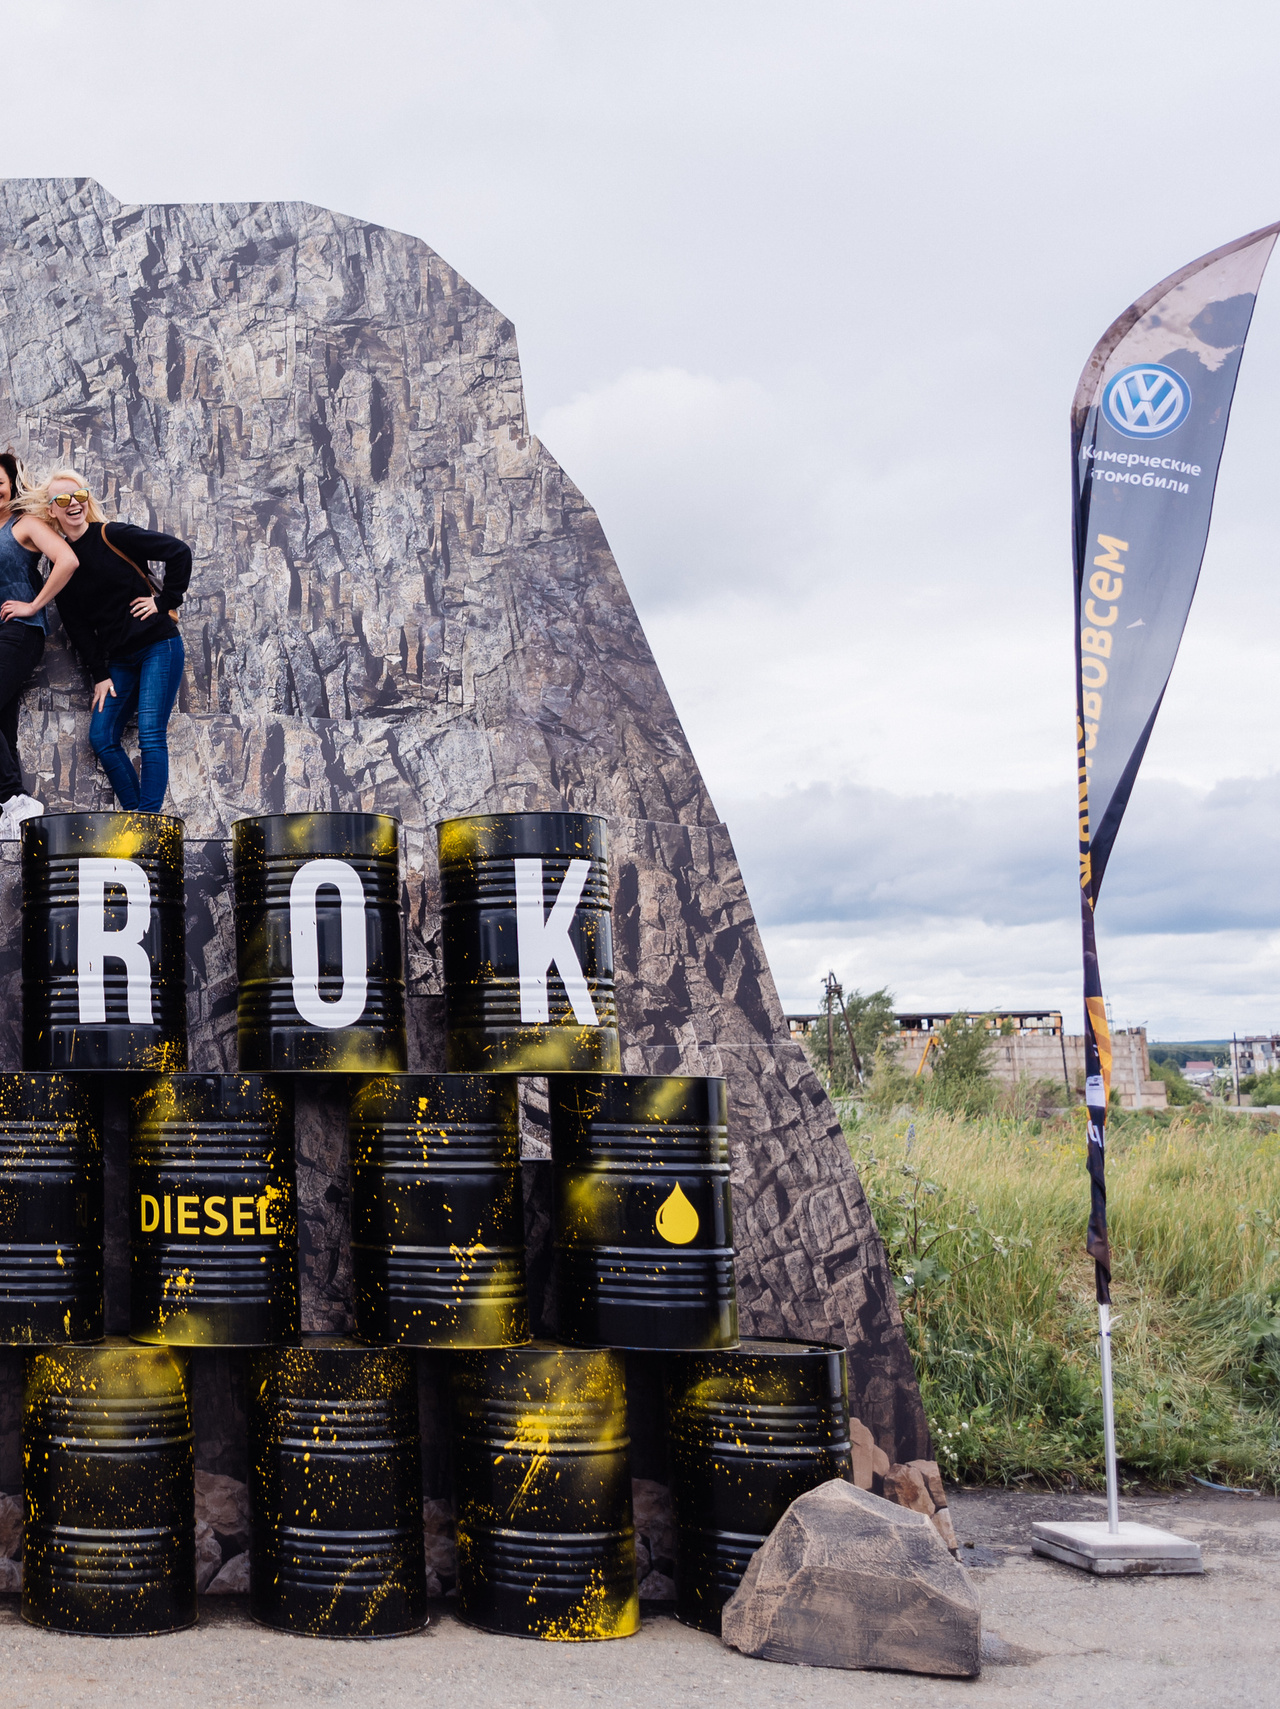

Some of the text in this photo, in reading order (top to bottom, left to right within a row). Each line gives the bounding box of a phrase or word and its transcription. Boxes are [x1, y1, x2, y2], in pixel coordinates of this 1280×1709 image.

[1082, 444, 1202, 477] Кммерческие
[1091, 467, 1190, 494] томобили
[140, 1194, 278, 1236] DIESEL
